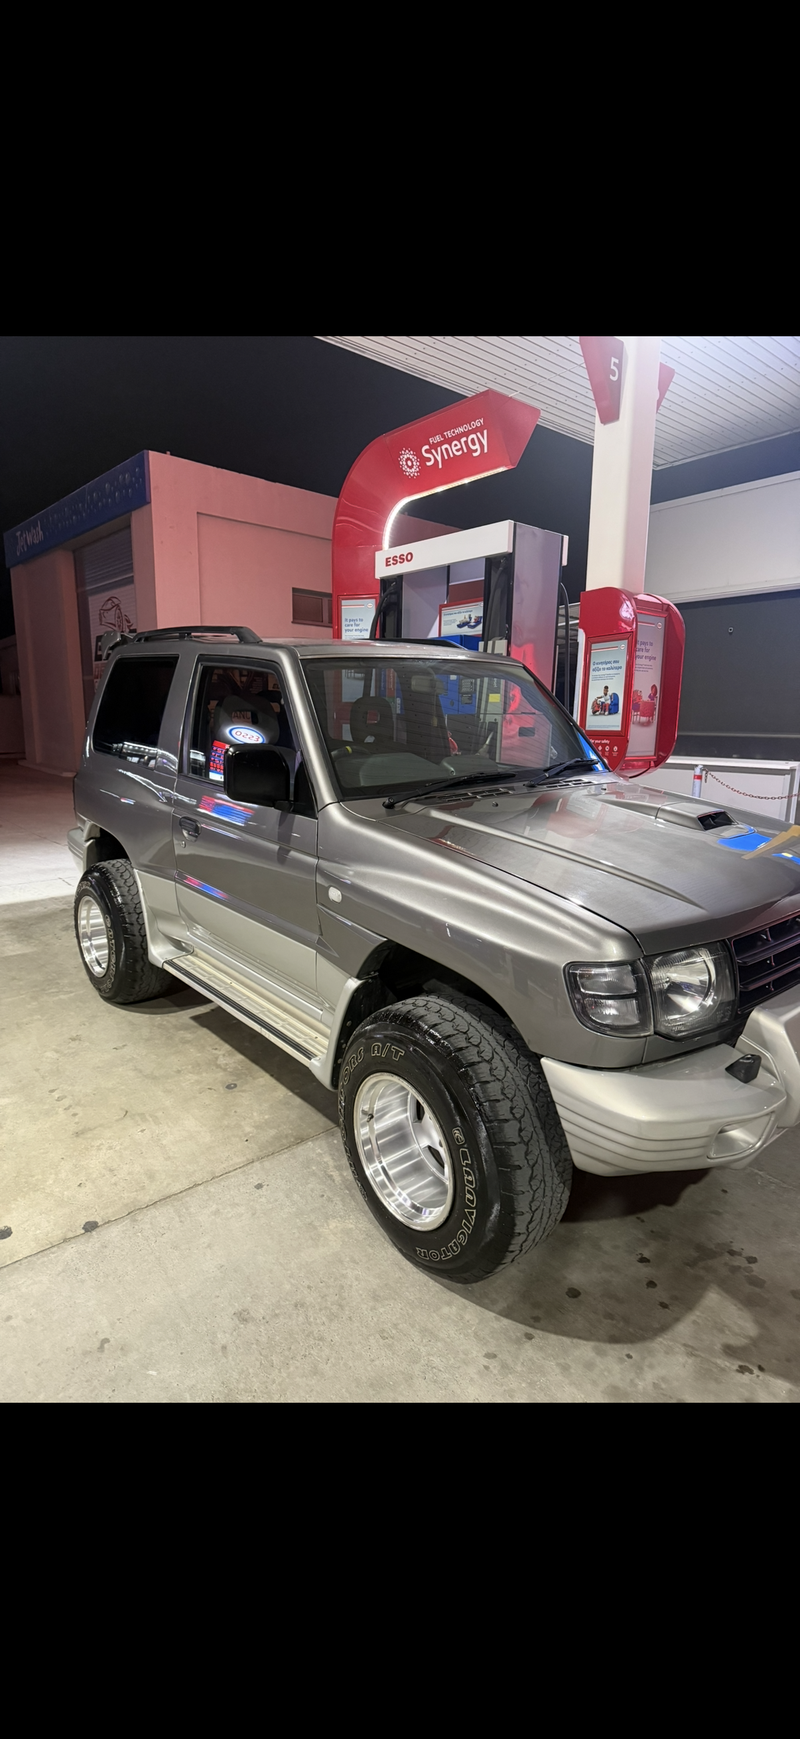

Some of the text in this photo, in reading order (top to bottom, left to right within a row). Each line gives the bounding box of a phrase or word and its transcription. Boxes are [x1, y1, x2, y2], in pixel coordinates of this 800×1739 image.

[609, 356, 619, 381] 5
[429, 418, 484, 445] FUEL TECHNOLOGY
[422, 429, 488, 468] Synergy
[385, 552, 413, 567] ESSO
[371, 1043, 405, 1061] A/T
